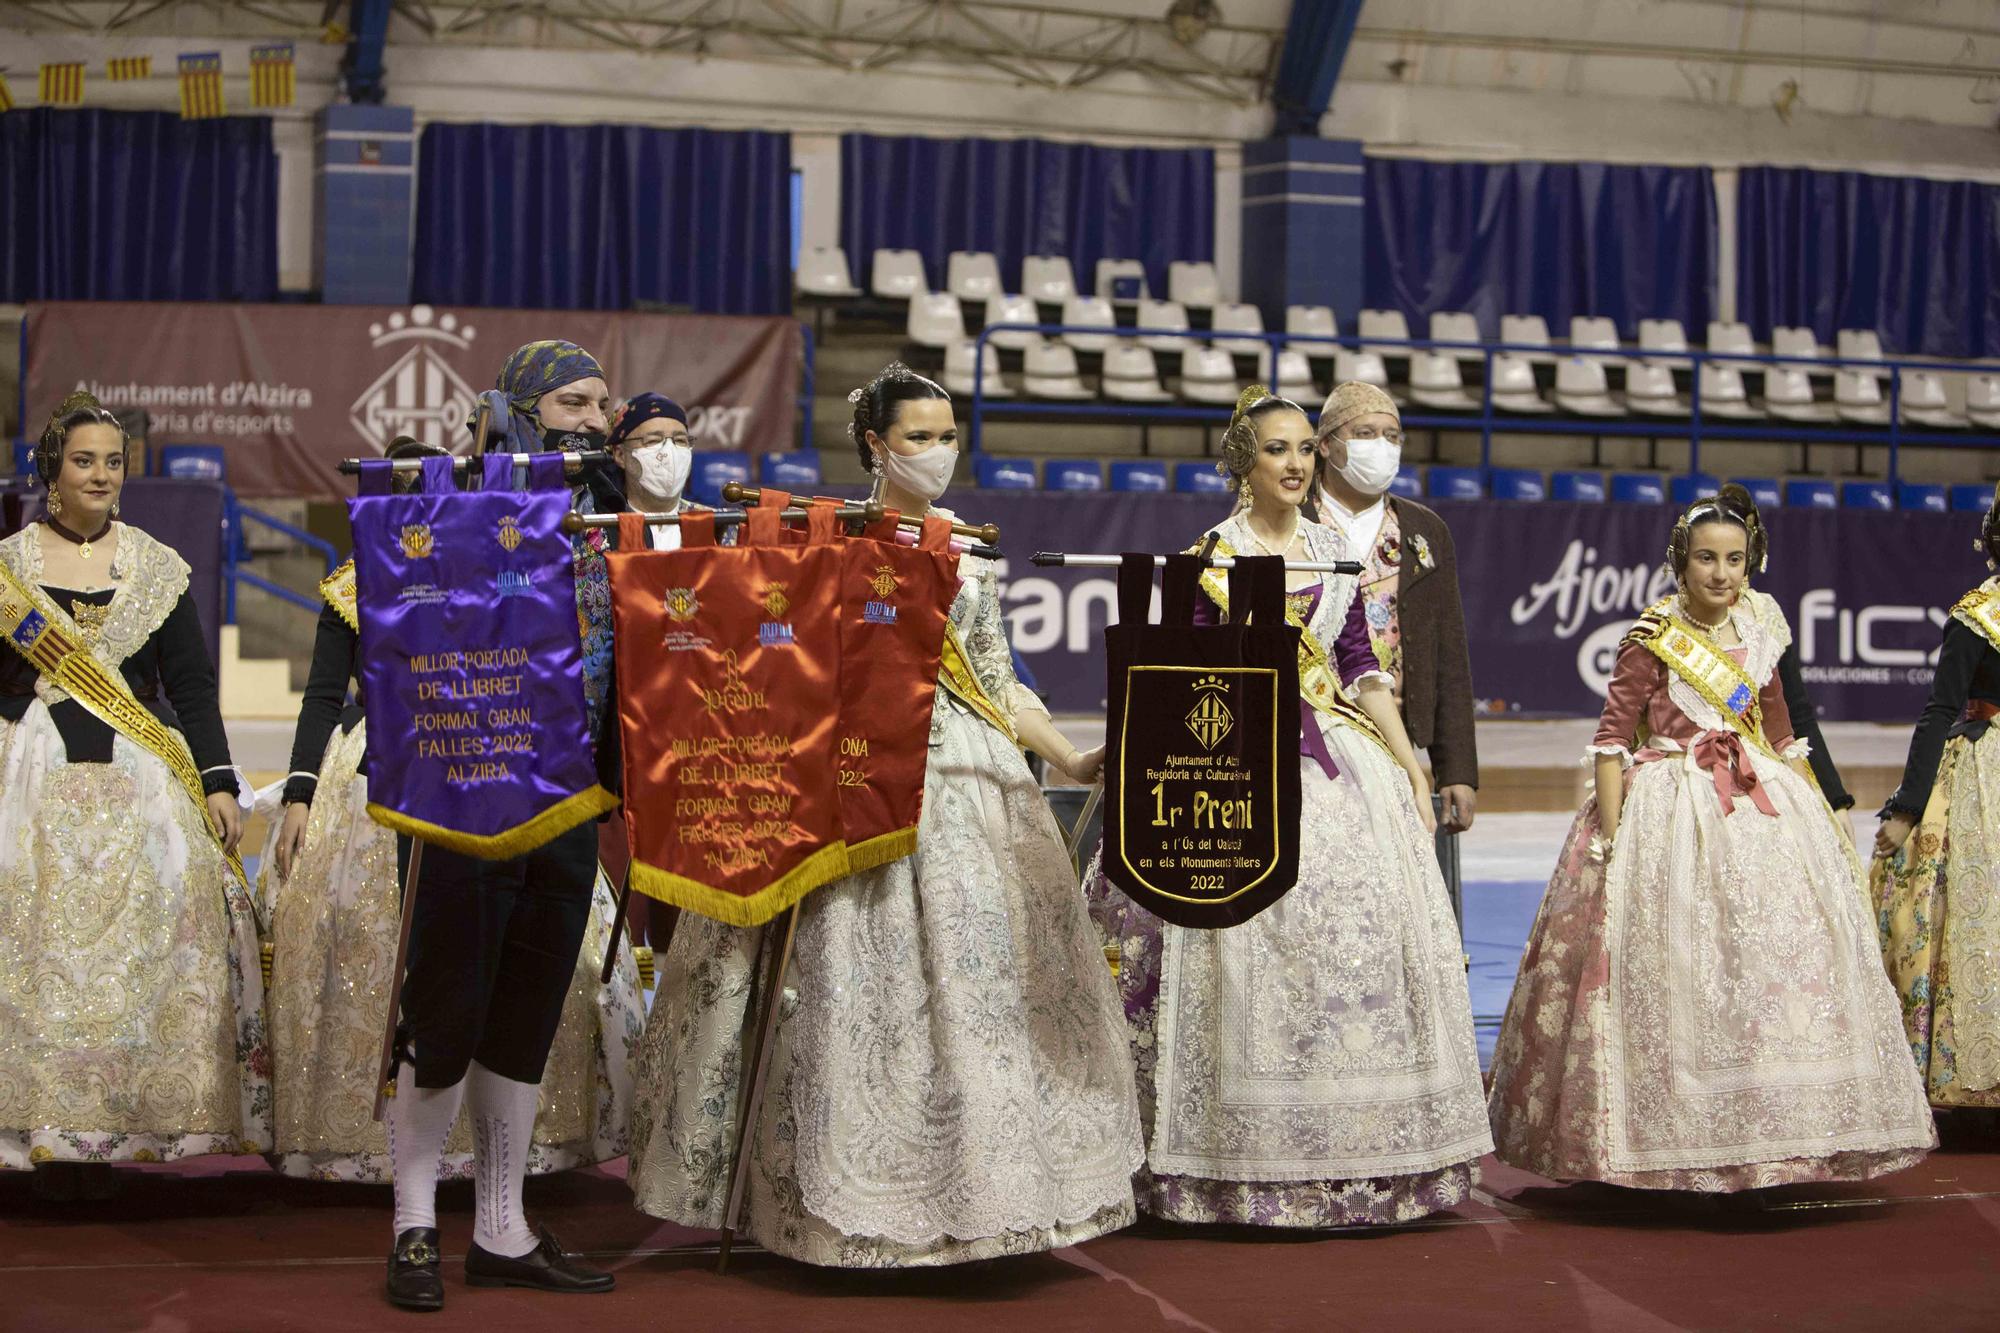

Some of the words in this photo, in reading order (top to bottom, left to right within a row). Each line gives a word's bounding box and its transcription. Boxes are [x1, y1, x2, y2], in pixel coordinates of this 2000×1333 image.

[220, 382, 313, 409] d'Alzira
[192, 410, 295, 437] d'esports
[410, 651, 459, 673] MILLOR
[464, 647, 530, 670] PORTADA
[1800, 666, 1891, 684] SOLUCIONES
[417, 681, 443, 700] DE
[451, 674, 524, 699] LLIBRET
[414, 710, 480, 733] FORMAT
[487, 706, 532, 729] GRAN
[418, 736, 484, 759] FALLES
[492, 733, 534, 753] 2022
[671, 736, 721, 760] MILLOR
[726, 734, 792, 756] PORTADA
[446, 761, 511, 784] ALZIRA
[1165, 754, 1214, 768] Ajuntament
[680, 766, 703, 785] DE
[712, 762, 787, 784] LLIBRET
[1146, 768, 1190, 782] Regidoria
[1193, 769, 1203, 780] de
[675, 795, 740, 817] FORMAT
[748, 794, 792, 814] GRAN
[1151, 782, 1183, 829] 1r
[679, 821, 744, 845] FALLES
[1161, 839, 1168, 851] a
[1198, 838, 1212, 851] del
[707, 848, 770, 870] ALZIRA
[1139, 857, 1153, 868] en
[1159, 856, 1175, 868] els
[1190, 875, 1225, 890] 2022
